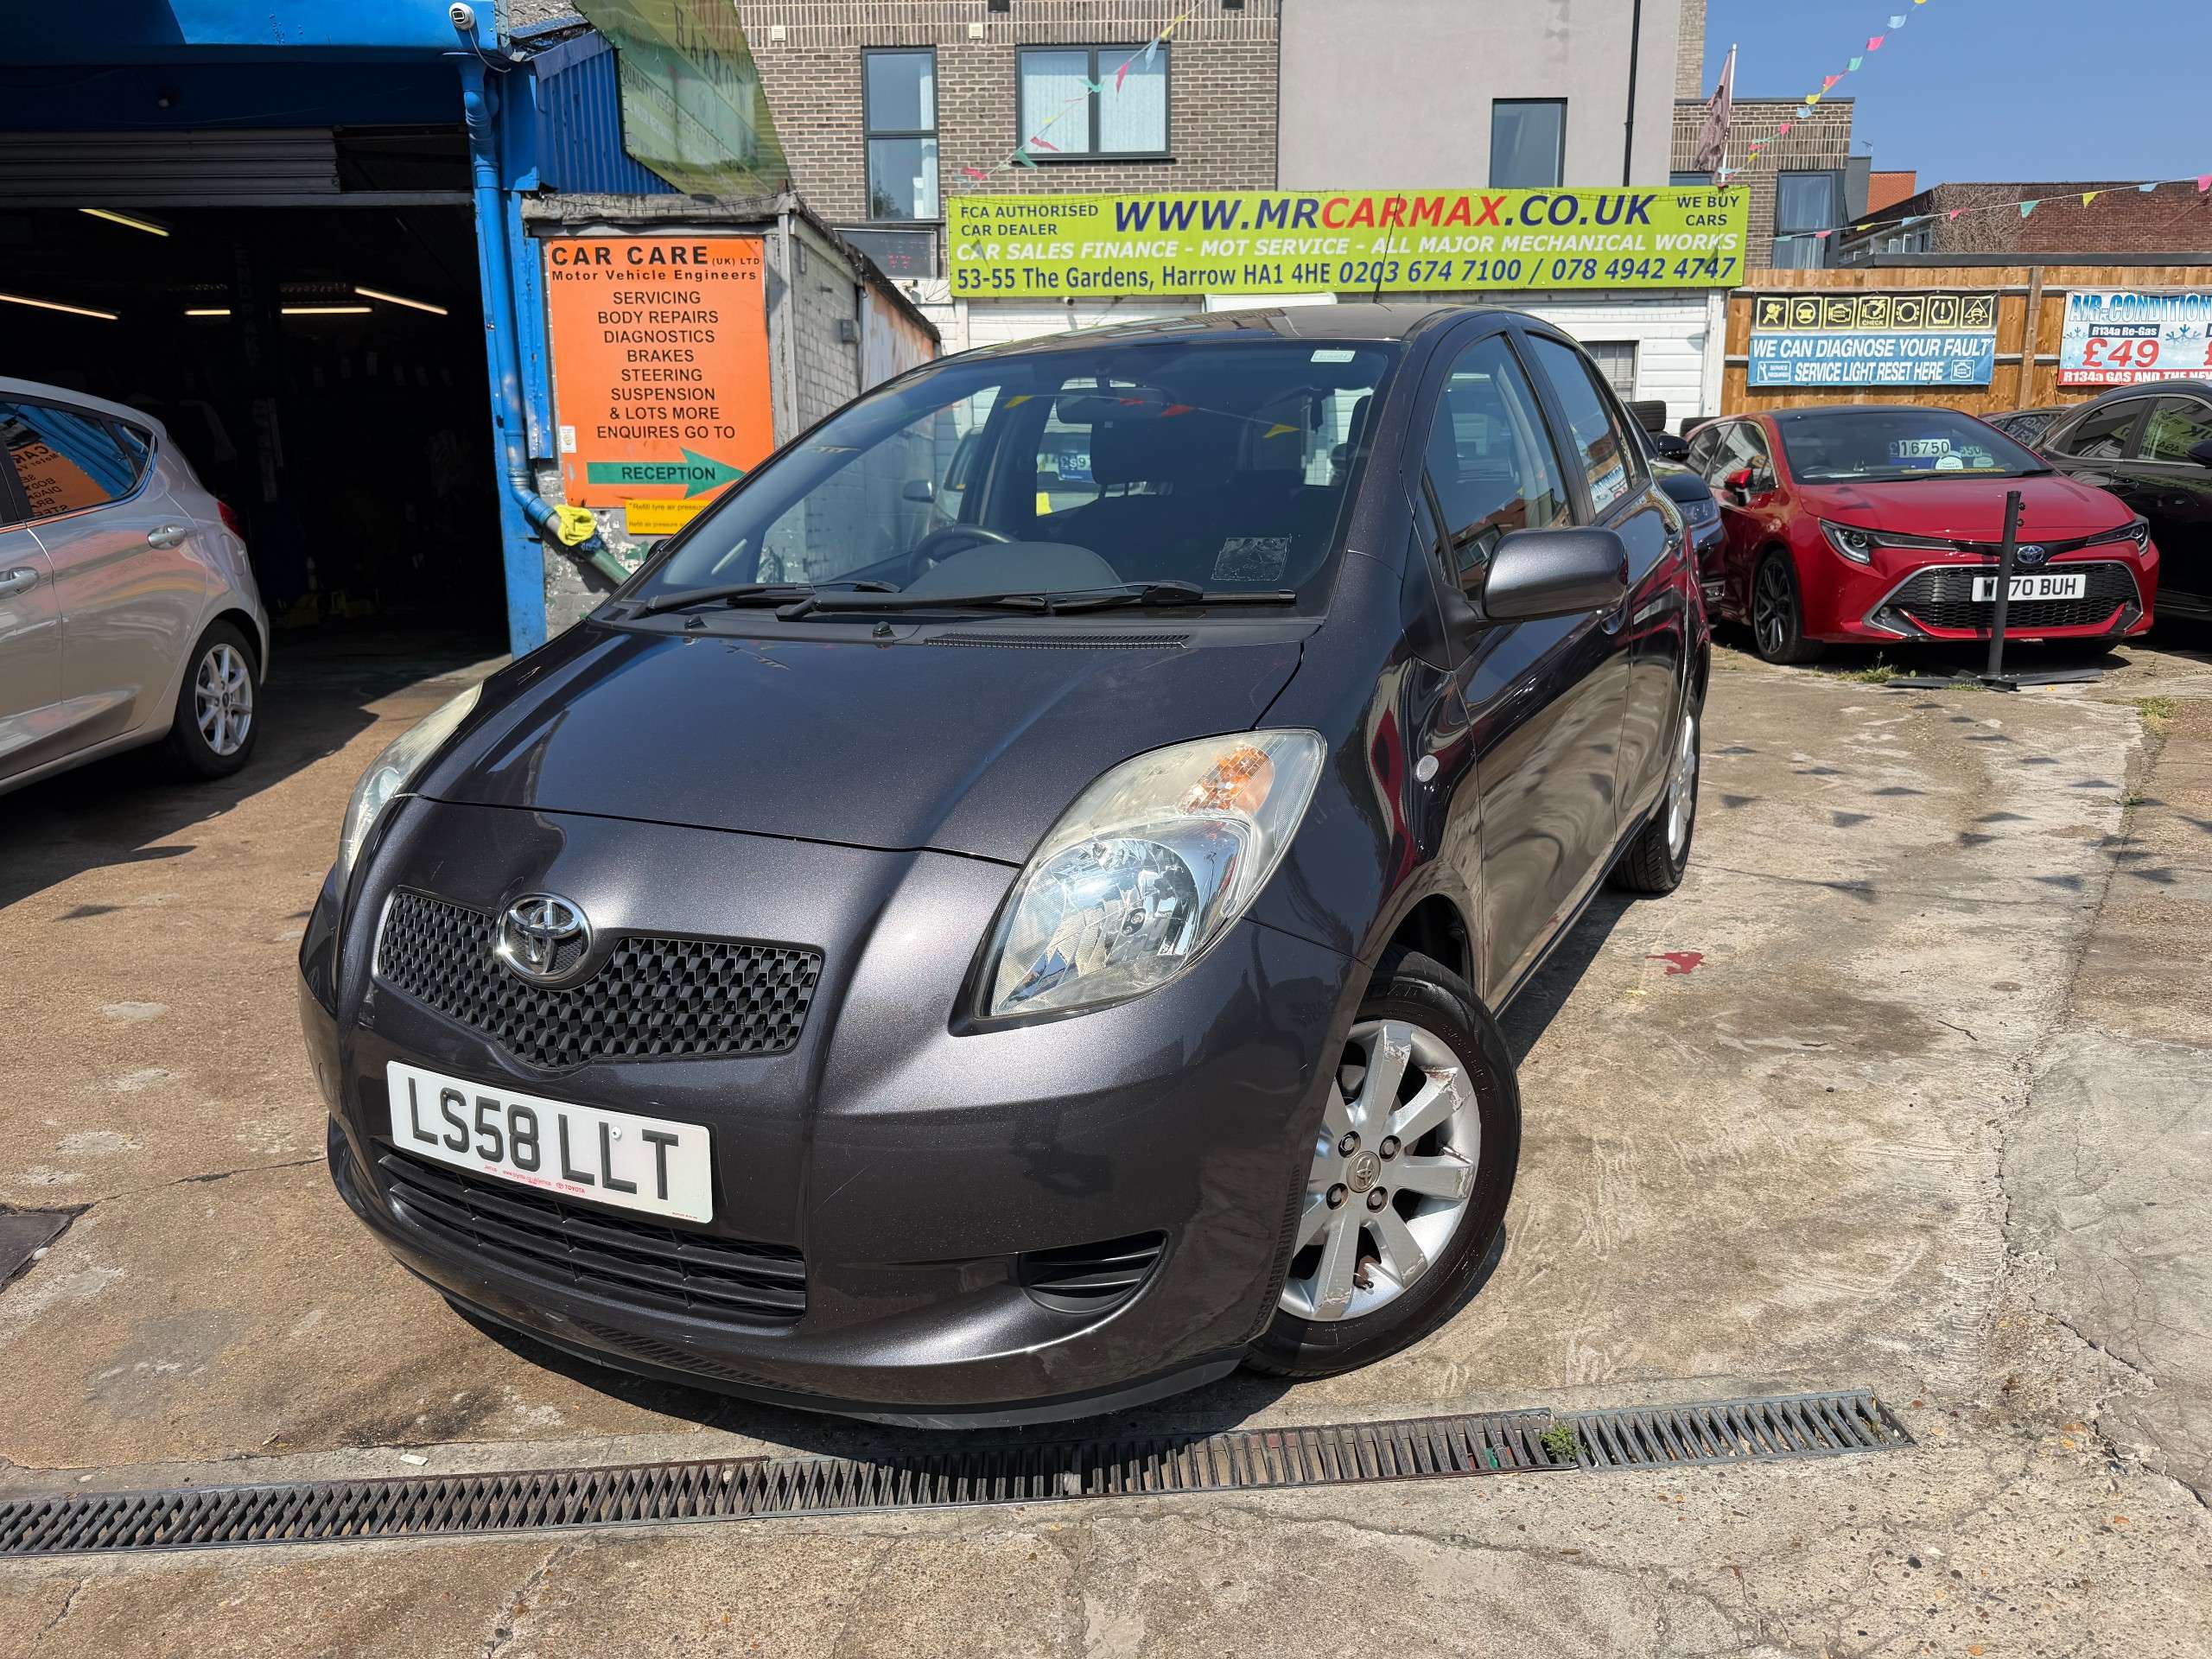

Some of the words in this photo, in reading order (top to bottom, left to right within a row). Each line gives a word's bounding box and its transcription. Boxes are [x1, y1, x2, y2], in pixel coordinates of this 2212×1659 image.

[1677, 197, 1704, 208] WE
[1707, 196, 1740, 208] BUY
[961, 206, 988, 219] FCA
[995, 205, 1098, 218] AUTHORISED
[1115, 194, 1656, 232] WWW.MRCARMAX.CO.UK
[1686, 213, 1727, 226] CARS
[961, 225, 992, 236] CAR
[997, 223, 1058, 236] DEALER
[957, 243, 1000, 260] CAR
[1007, 242, 1075, 259] SALES
[1081, 241, 1178, 258] FINANCE
[1199, 240, 1251, 257] MOT
[1255, 238, 1349, 256] SERVICE
[1370, 237, 1411, 254] ALL
[1420, 236, 1494, 253] MAJOR
[1501, 234, 1647, 252] MECHANICAL
[1655, 232, 1738, 251] WORKS
[551, 246, 611, 265] CAR
[627, 246, 708, 265] CARE
[712, 257, 735, 266] (UK)
[552, 270, 598, 281] Motor
[607, 270, 665, 281] Vehicle
[674, 270, 756, 283] Engineers
[957, 269, 1015, 289] 53-55
[1023, 267, 1058, 289] The
[1068, 265, 1154, 291] Gardens,
[1162, 265, 1236, 286] Harrow
[1243, 264, 1283, 285] HA1
[1292, 263, 1330, 284] 4HE
[1339, 261, 1398, 283] 0203
[1408, 260, 1452, 282] 674
[1463, 259, 1521, 282] 7100
[1528, 258, 1544, 284] /
[1552, 259, 1597, 280] 078
[1605, 258, 1665, 280] 4942
[1674, 257, 1736, 279] 4747
[613, 291, 701, 305] SERVICING
[598, 311, 643, 325] BODY
[649, 311, 718, 324] REPAIRS
[604, 330, 715, 343] DIAGNOSTICS
[1753, 340, 1775, 358] WE
[1780, 339, 1812, 358] CAN
[1815, 339, 1894, 357] DIAGNOSE
[1899, 338, 1942, 357] YOUR
[1942, 338, 1988, 356] FAULT
[2082, 338, 2159, 368] £49
[627, 350, 694, 363] BRAKES
[621, 368, 702, 382] STEERING
[1795, 362, 1840, 382] SERVICE
[1842, 362, 1876, 381] LIGHT
[1878, 362, 1911, 381] RESET
[1914, 361, 1943, 380] HERE
[2106, 371, 2132, 382] GAS
[2134, 371, 2160, 381] AND
[611, 388, 715, 401] SUSPENSION
[610, 407, 620, 419] &
[626, 407, 667, 420] LOTS
[673, 407, 719, 419] MORE
[597, 426, 679, 440] ENQUIRES
[684, 426, 709, 439] GO
[713, 426, 735, 439] TO
[622, 467, 715, 480] RECEPTION
[1983, 579, 2034, 597] W70
[2039, 578, 2076, 595] BUH
[409, 1077, 541, 1173] LS58
[558, 1114, 680, 1200] LLT
